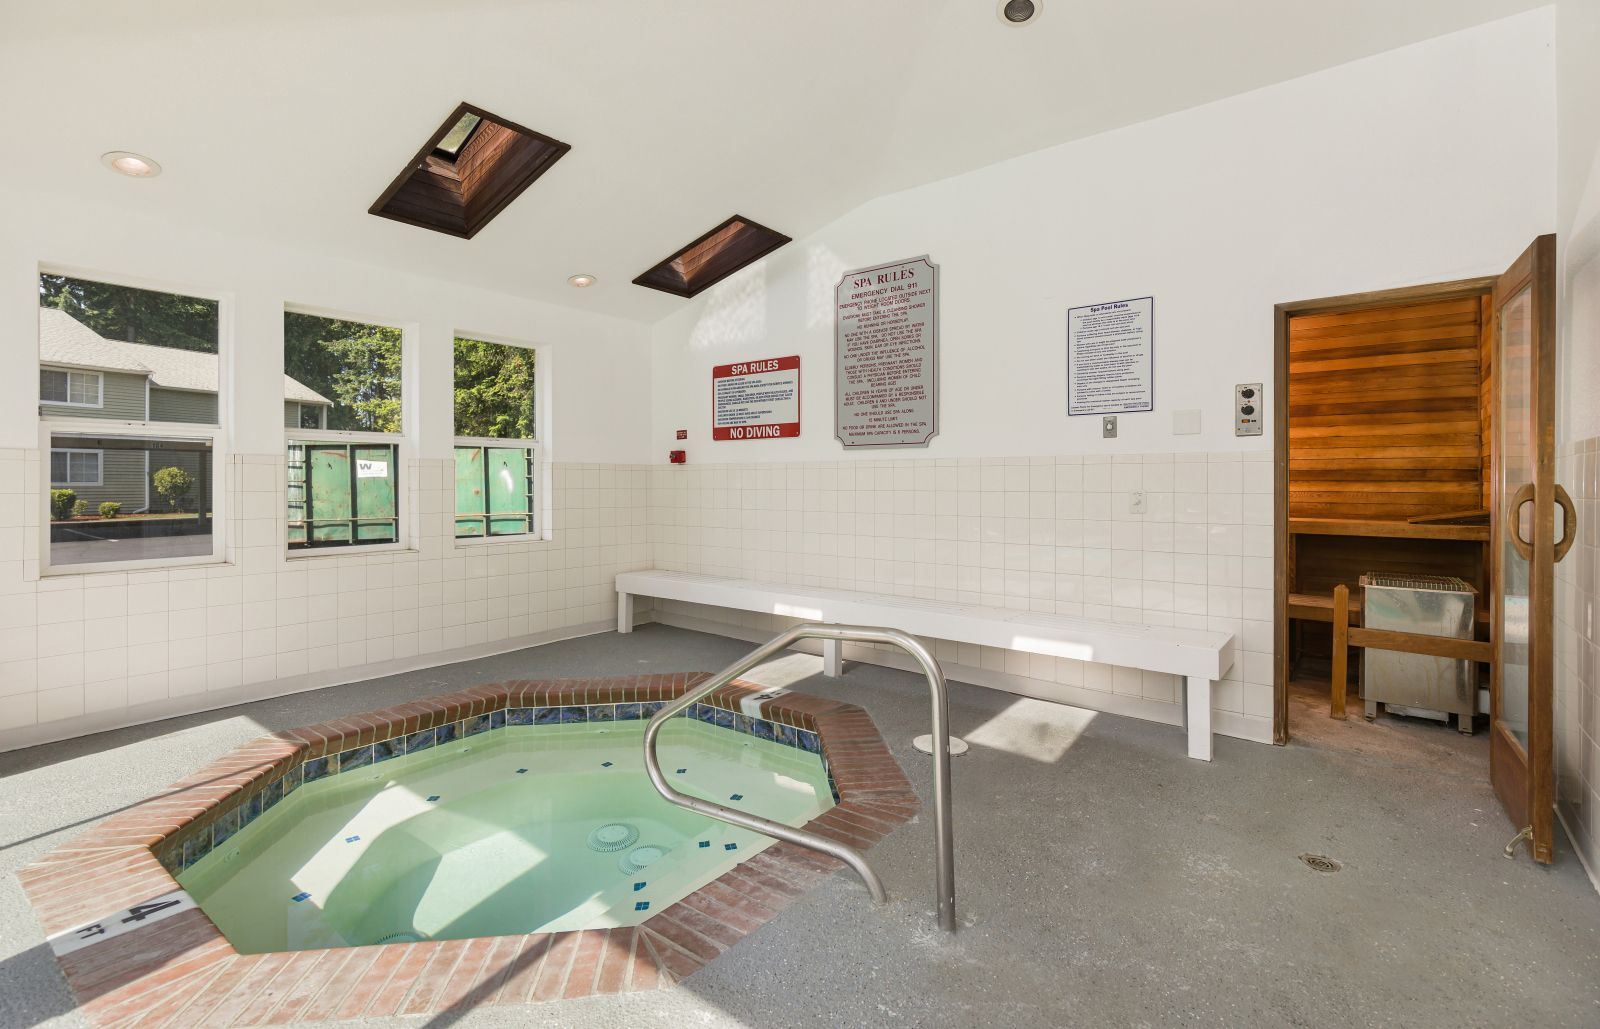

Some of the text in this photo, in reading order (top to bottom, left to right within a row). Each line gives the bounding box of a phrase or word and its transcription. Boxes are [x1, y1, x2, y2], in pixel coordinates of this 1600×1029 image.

[854, 268, 914, 288] SPA RULES
[852, 288, 888, 300] EMERGENCY
[898, 291, 918, 299] OUTSIDE
[732, 360, 778, 374] SPA RULES
[730, 426, 780, 438] NO DIVING
[76, 900, 181, 940] 4 FT
